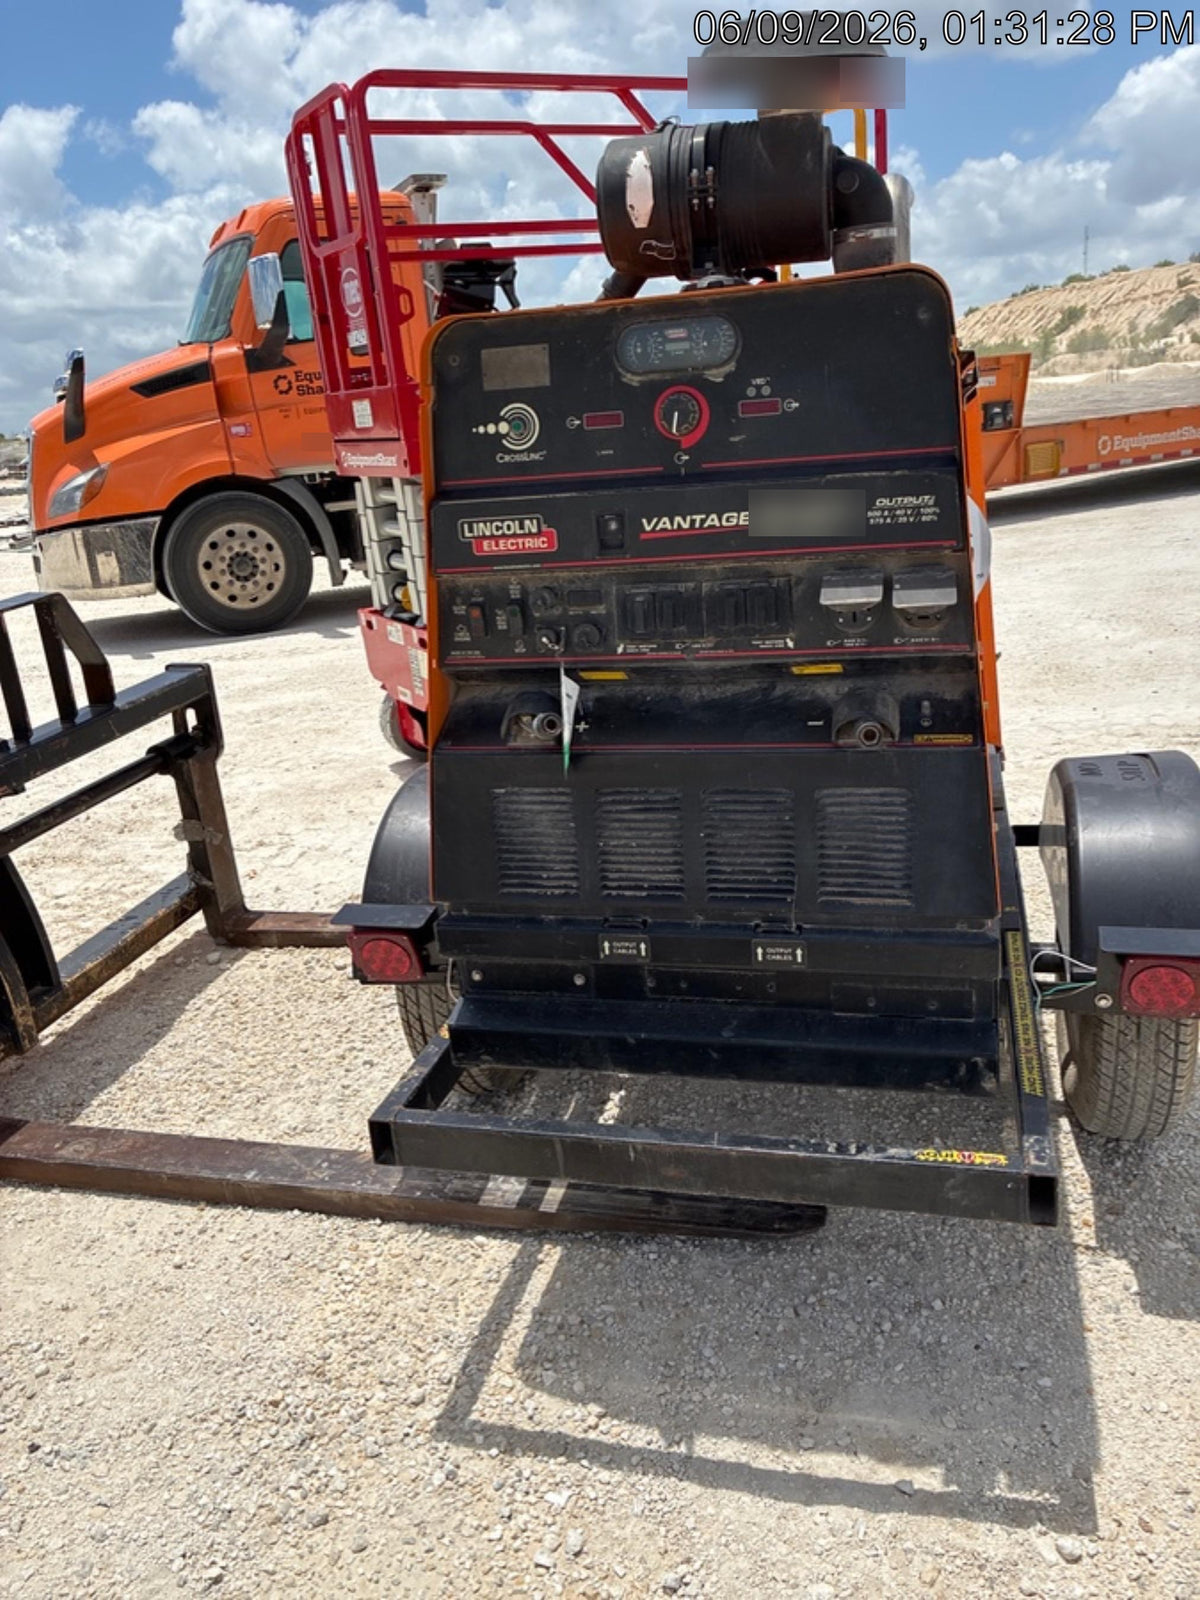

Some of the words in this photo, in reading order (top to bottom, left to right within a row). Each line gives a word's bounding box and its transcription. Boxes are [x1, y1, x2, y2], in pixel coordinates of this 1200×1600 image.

[294, 370, 323, 383] Equ
[296, 384, 326, 396] Sha
[875, 495, 931, 506] OUTPUT
[641, 511, 749, 532] VANTAGE
[463, 519, 538, 538] LINCOLN
[483, 537, 548, 551] ELECTRIC
